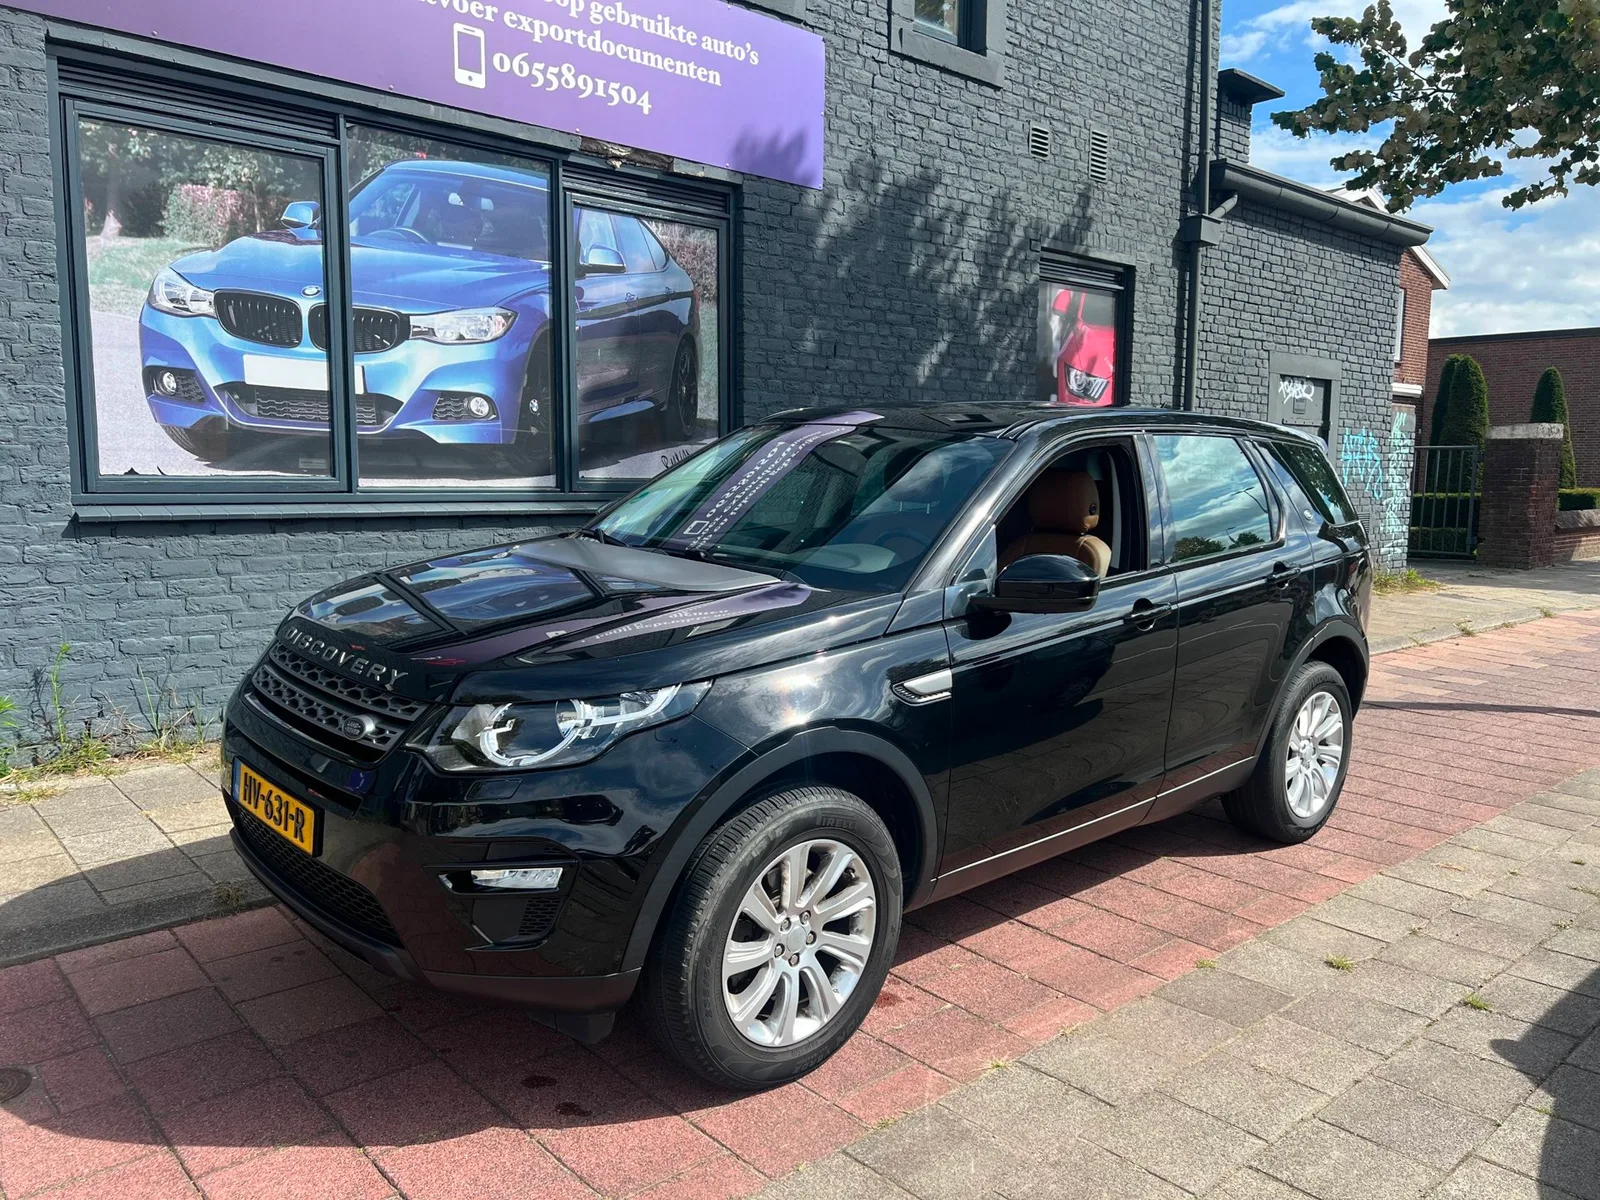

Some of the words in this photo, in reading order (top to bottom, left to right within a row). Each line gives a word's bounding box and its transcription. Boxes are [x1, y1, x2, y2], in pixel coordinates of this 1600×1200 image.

[503, 10, 722, 87] exportdocumenten
[589, 1, 698, 46] gebruikte
[701, 35, 759, 65] auto's
[492, 52, 652, 115] 0655891504
[284, 626, 409, 691] DISCOVERY
[242, 771, 305, 844] HV-631-R
